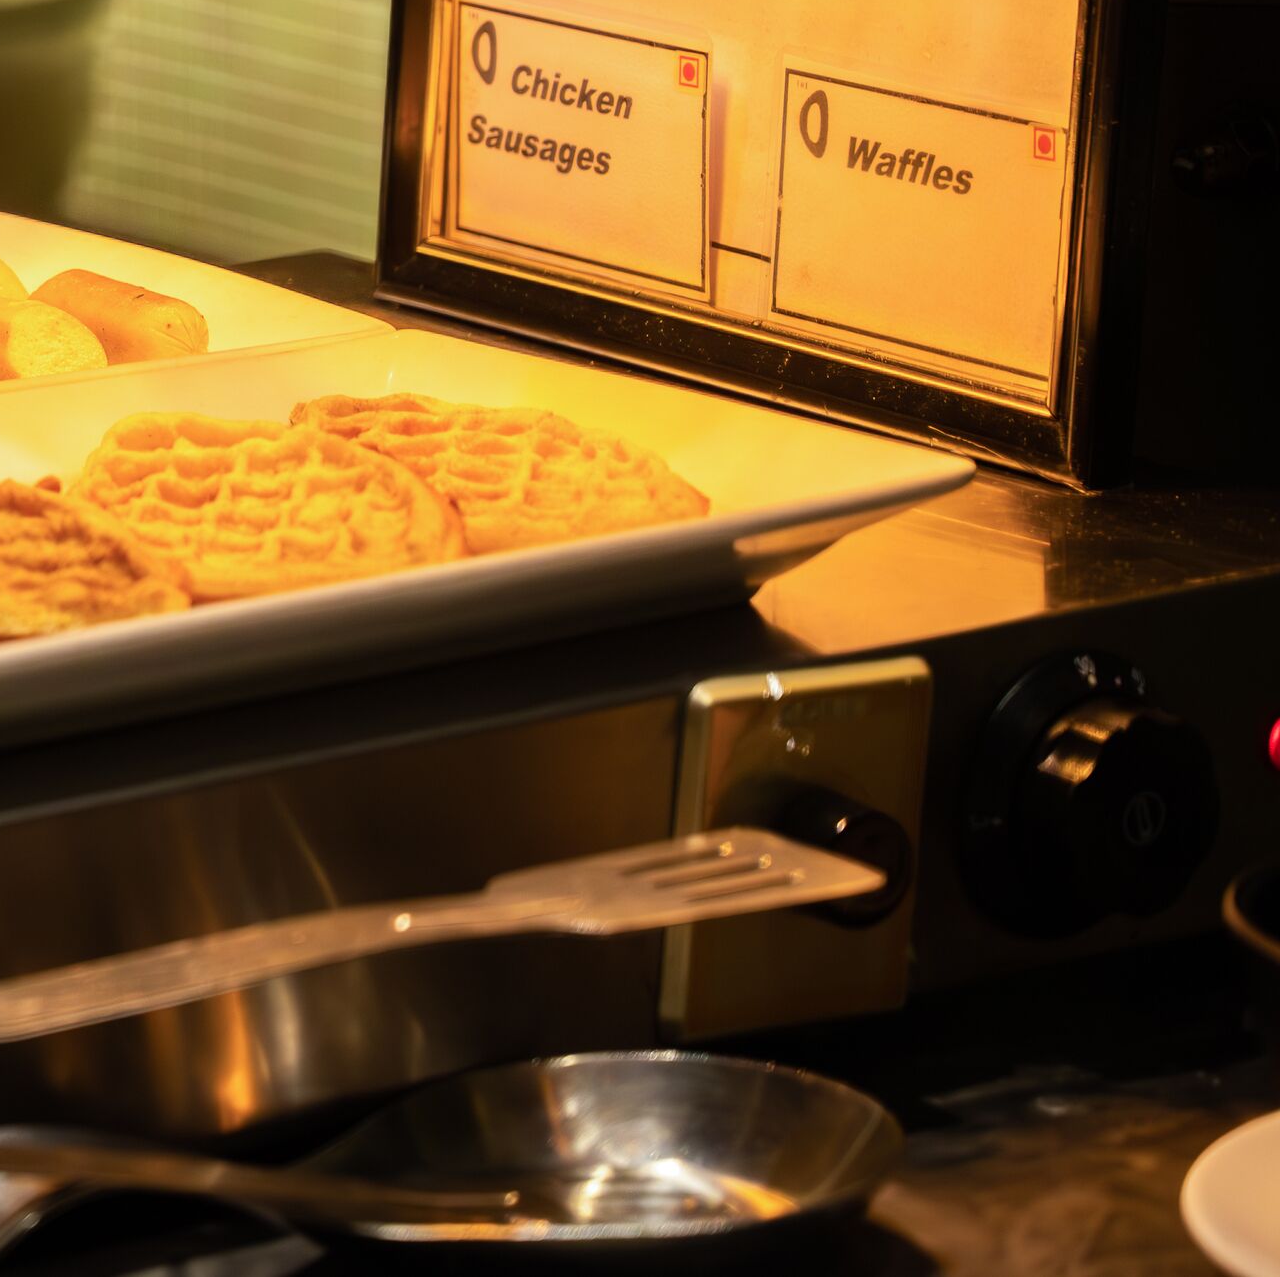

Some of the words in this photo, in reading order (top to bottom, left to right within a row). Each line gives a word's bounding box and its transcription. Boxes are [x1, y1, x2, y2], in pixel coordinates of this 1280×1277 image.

[510, 63, 633, 120] Chicken
[467, 113, 612, 177] Sausages
[845, 135, 975, 196] Waffles
